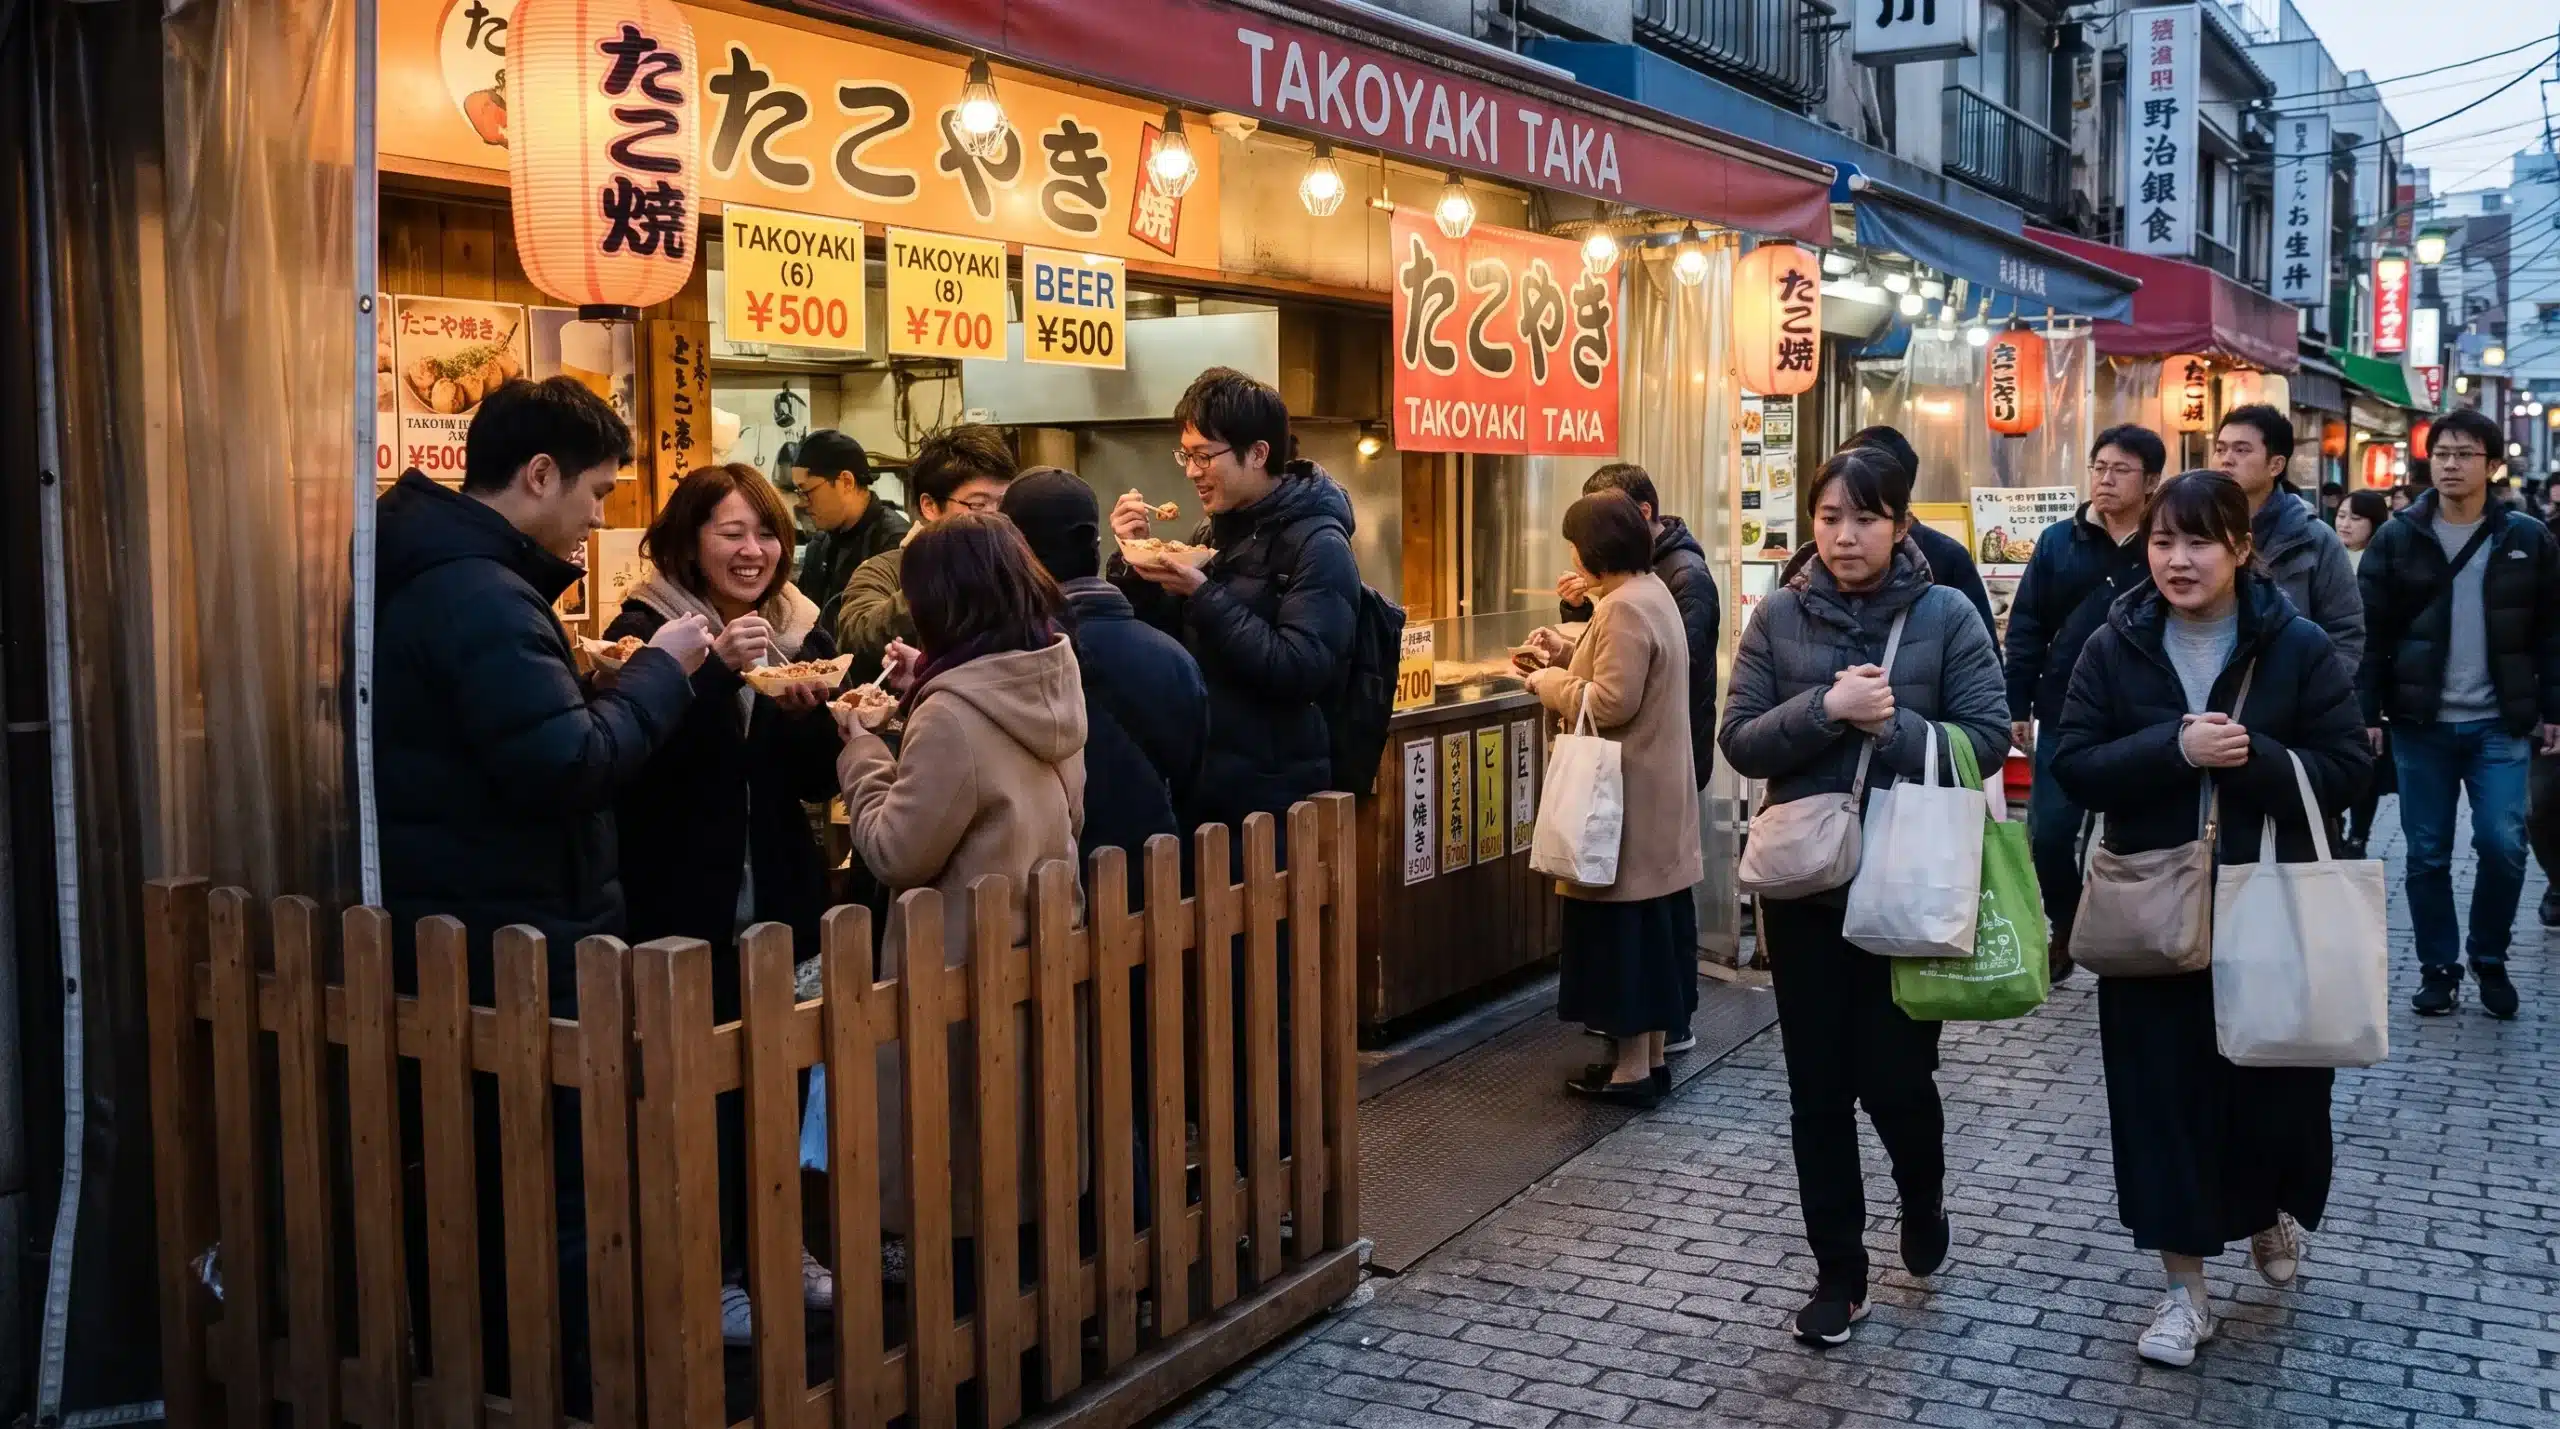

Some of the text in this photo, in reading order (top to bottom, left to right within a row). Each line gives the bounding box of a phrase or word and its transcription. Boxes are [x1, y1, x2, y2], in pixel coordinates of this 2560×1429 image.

[1237, 28, 1622, 194] TAKOYAKI TAKA
[600, 24, 686, 260] たこ焼
[708, 47, 1109, 233] たこやき
[733, 222, 855, 262] TAKOYAKI
[893, 243, 1000, 280] TAKOYAKI
[780, 260, 814, 290] (6)
[934, 278, 963, 304] (8)
[1035, 263, 1115, 310] BEER
[400, 310, 494, 341] たこや焼き
[746, 290, 848, 340] ¥500
[906, 306, 993, 350] ¥700
[1401, 233, 1611, 388] たこやき
[1777, 268, 1816, 372] たこ焼
[1037, 314, 1114, 357] ¥500
[1405, 397, 1604, 443] TAKOYAKI TAKA
[1412, 750, 1428, 854] たこ焼き
[1484, 742, 1497, 829] ビール
